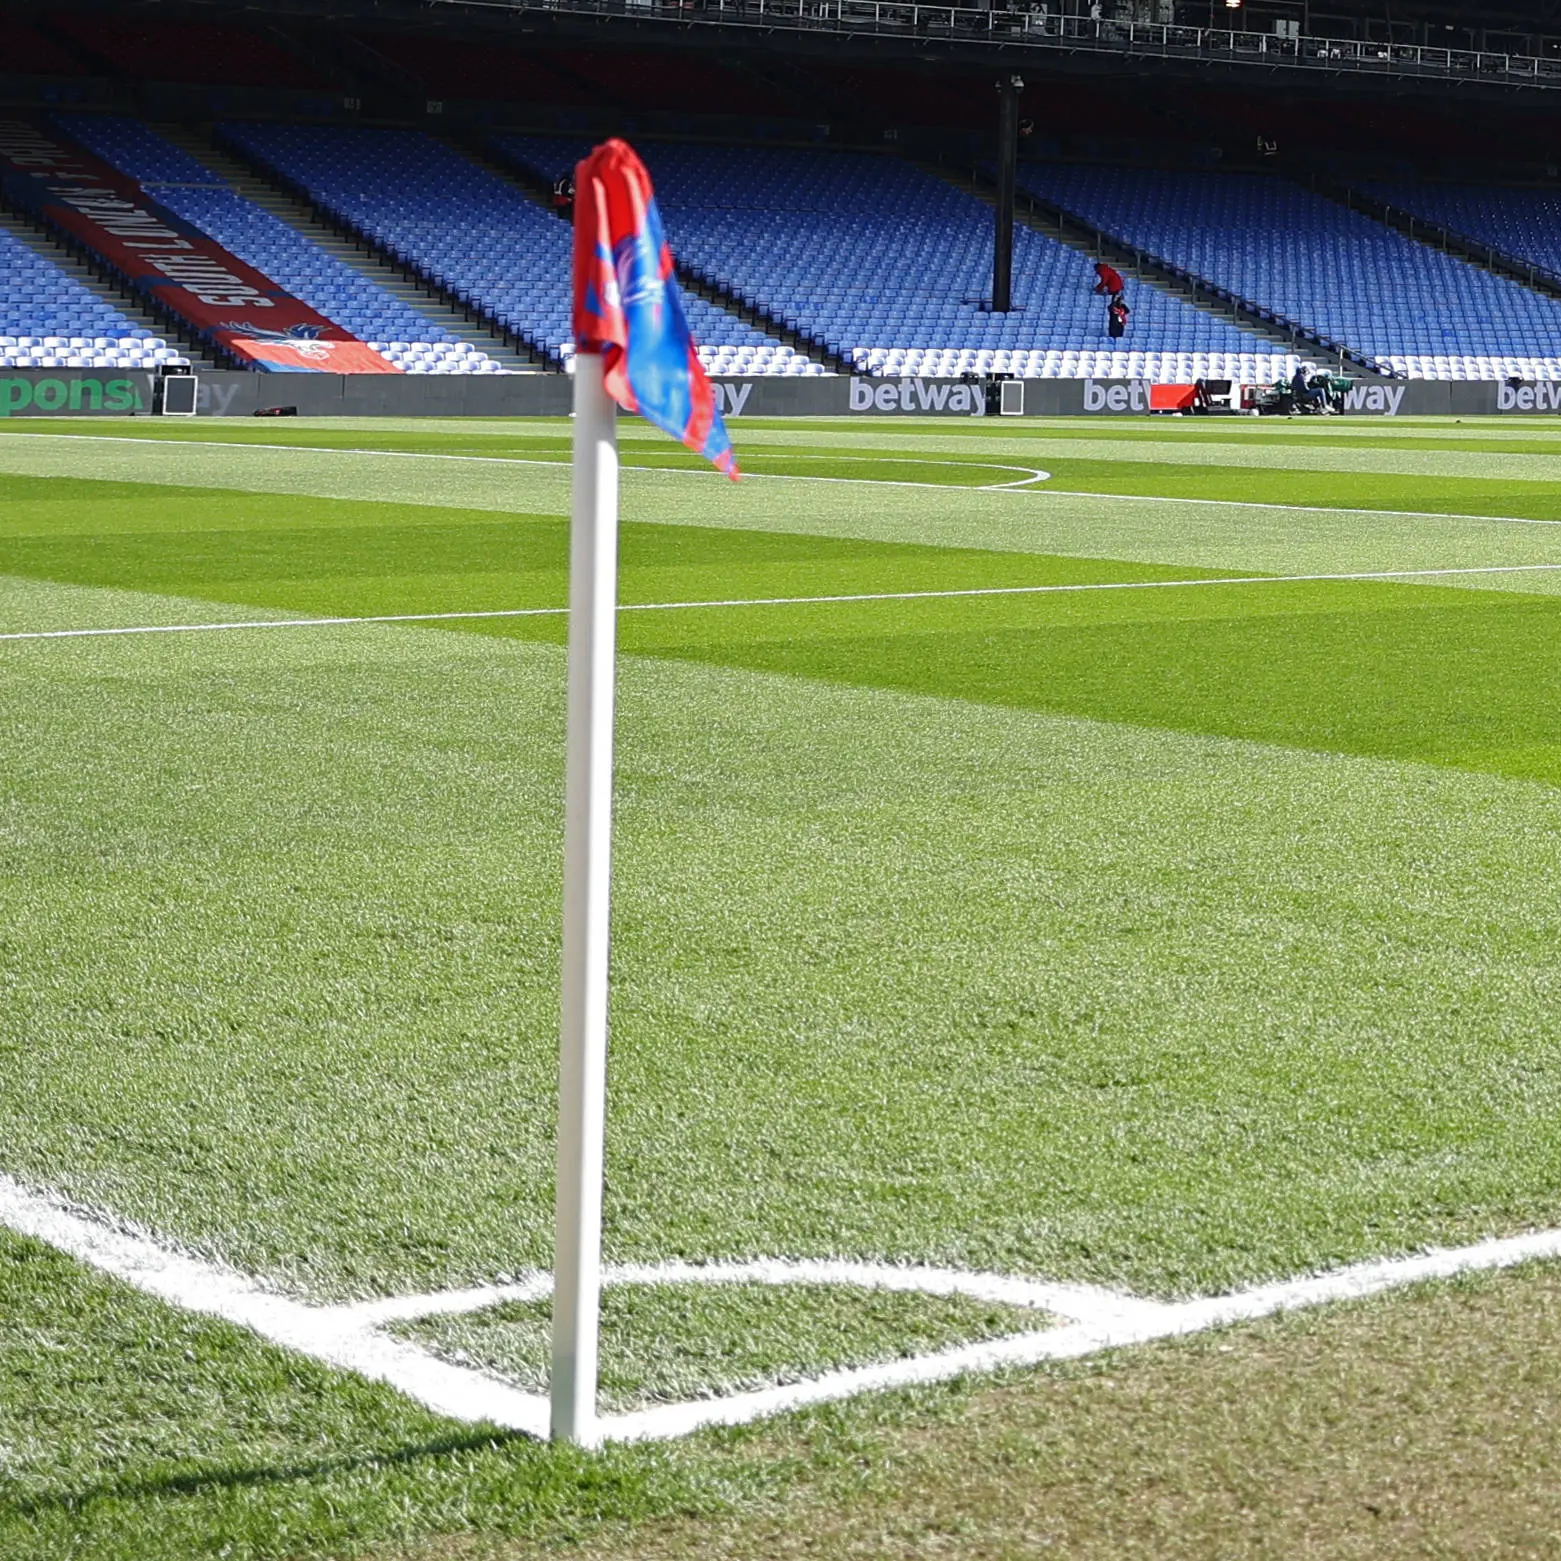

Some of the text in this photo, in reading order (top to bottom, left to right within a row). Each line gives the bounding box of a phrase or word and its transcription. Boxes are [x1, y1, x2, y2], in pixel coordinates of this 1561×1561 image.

[47, 187, 196, 251] LONDON
[137, 253, 276, 308] SOUTH
[848, 377, 986, 416] betway
